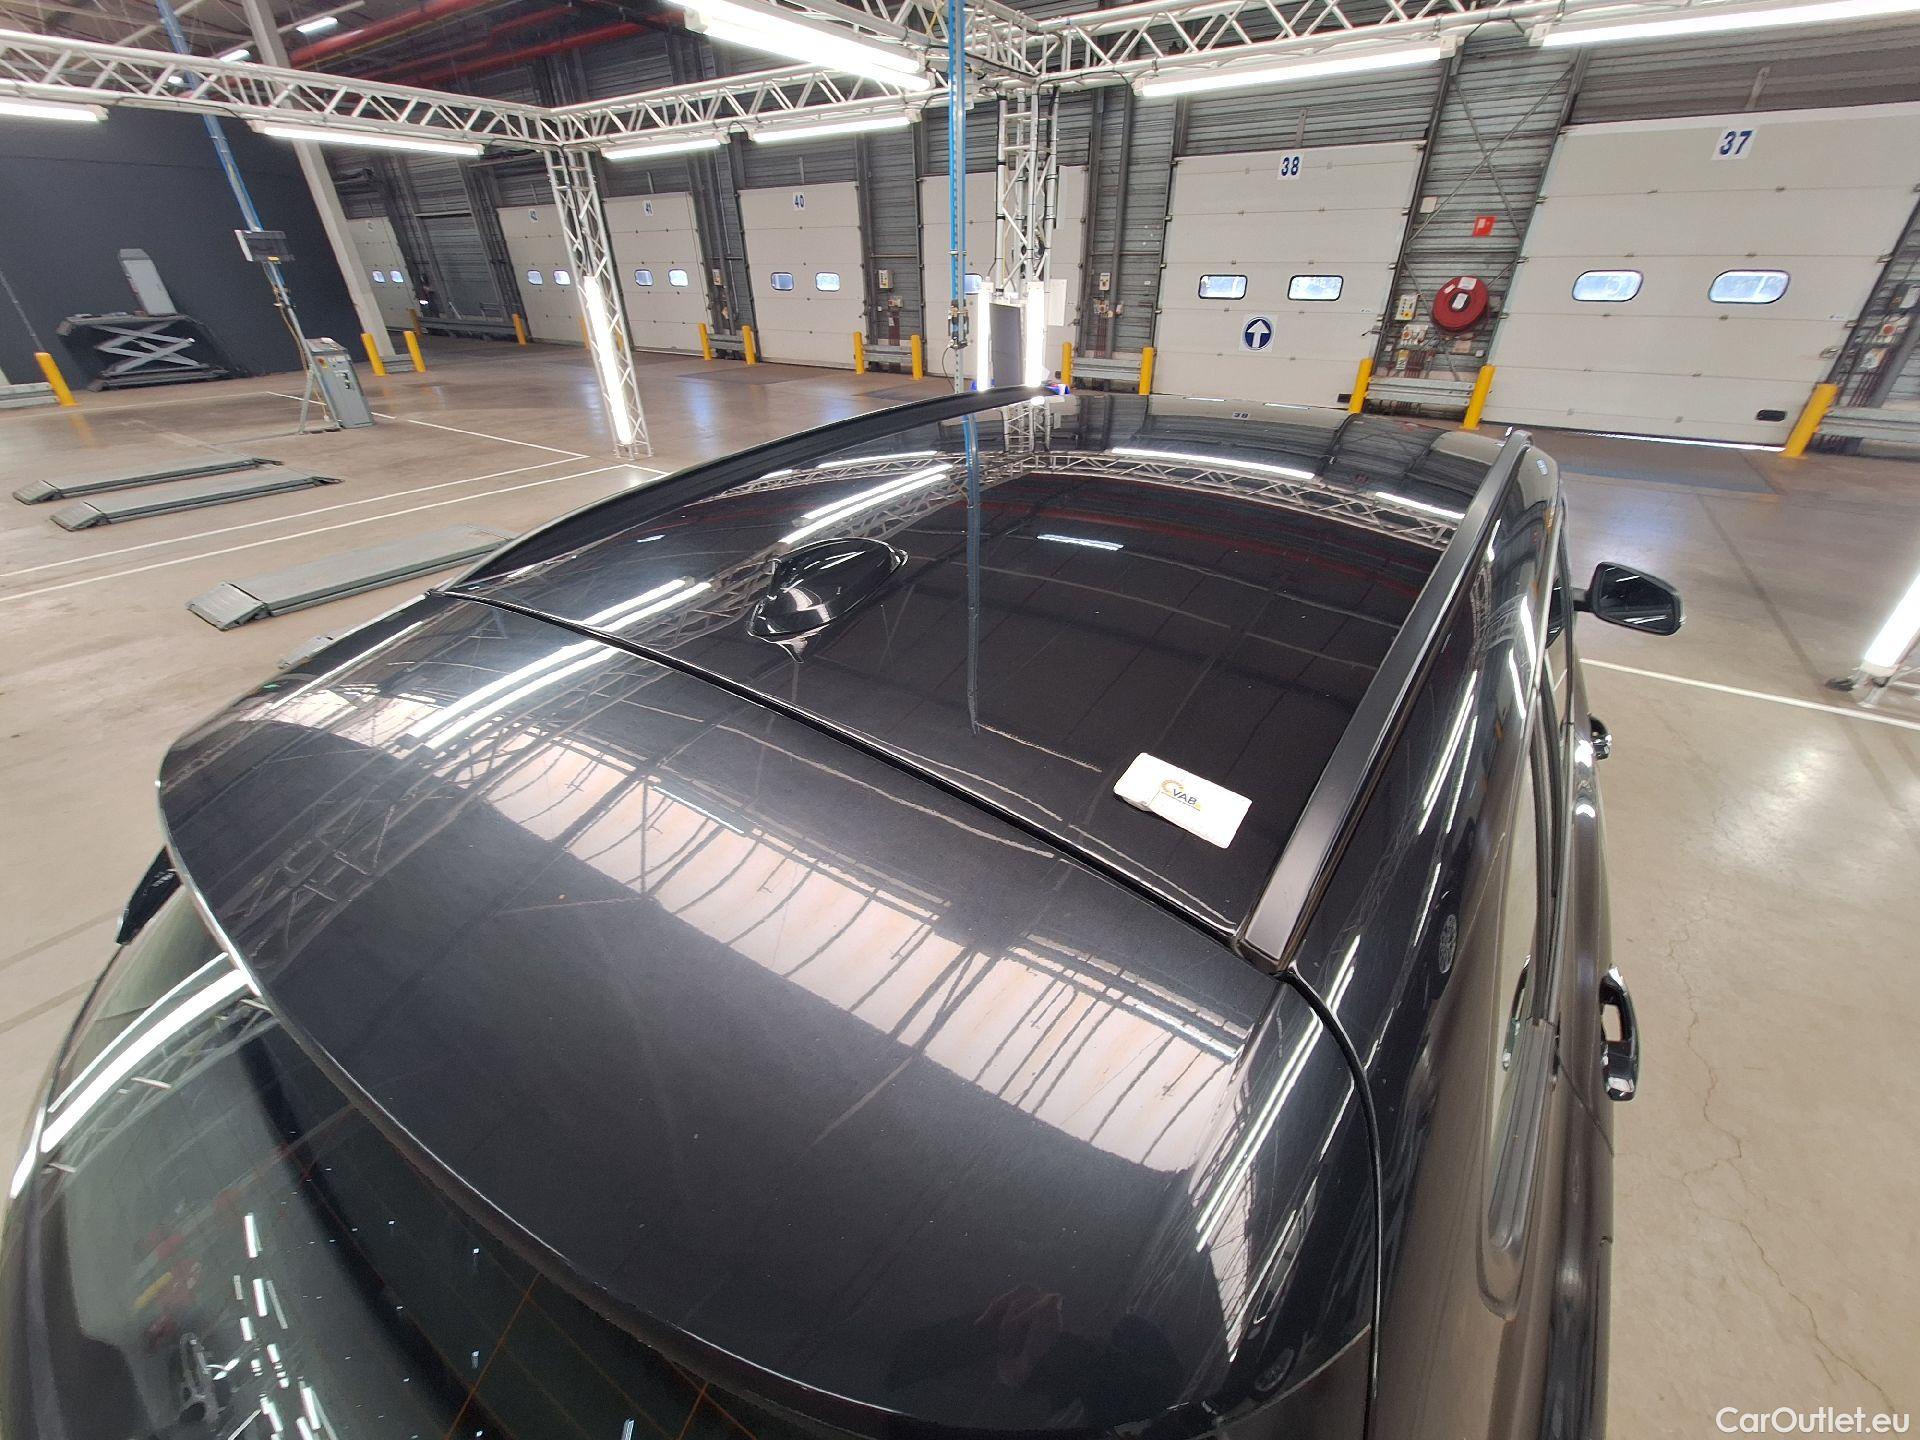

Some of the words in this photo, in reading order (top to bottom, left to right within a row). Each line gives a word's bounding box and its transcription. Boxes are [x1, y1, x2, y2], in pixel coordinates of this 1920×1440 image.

[1720, 130, 1752, 155] 37
[1282, 156, 1300, 176] 38
[795, 195, 804, 208] 40
[1172, 788, 1198, 805] VAB
